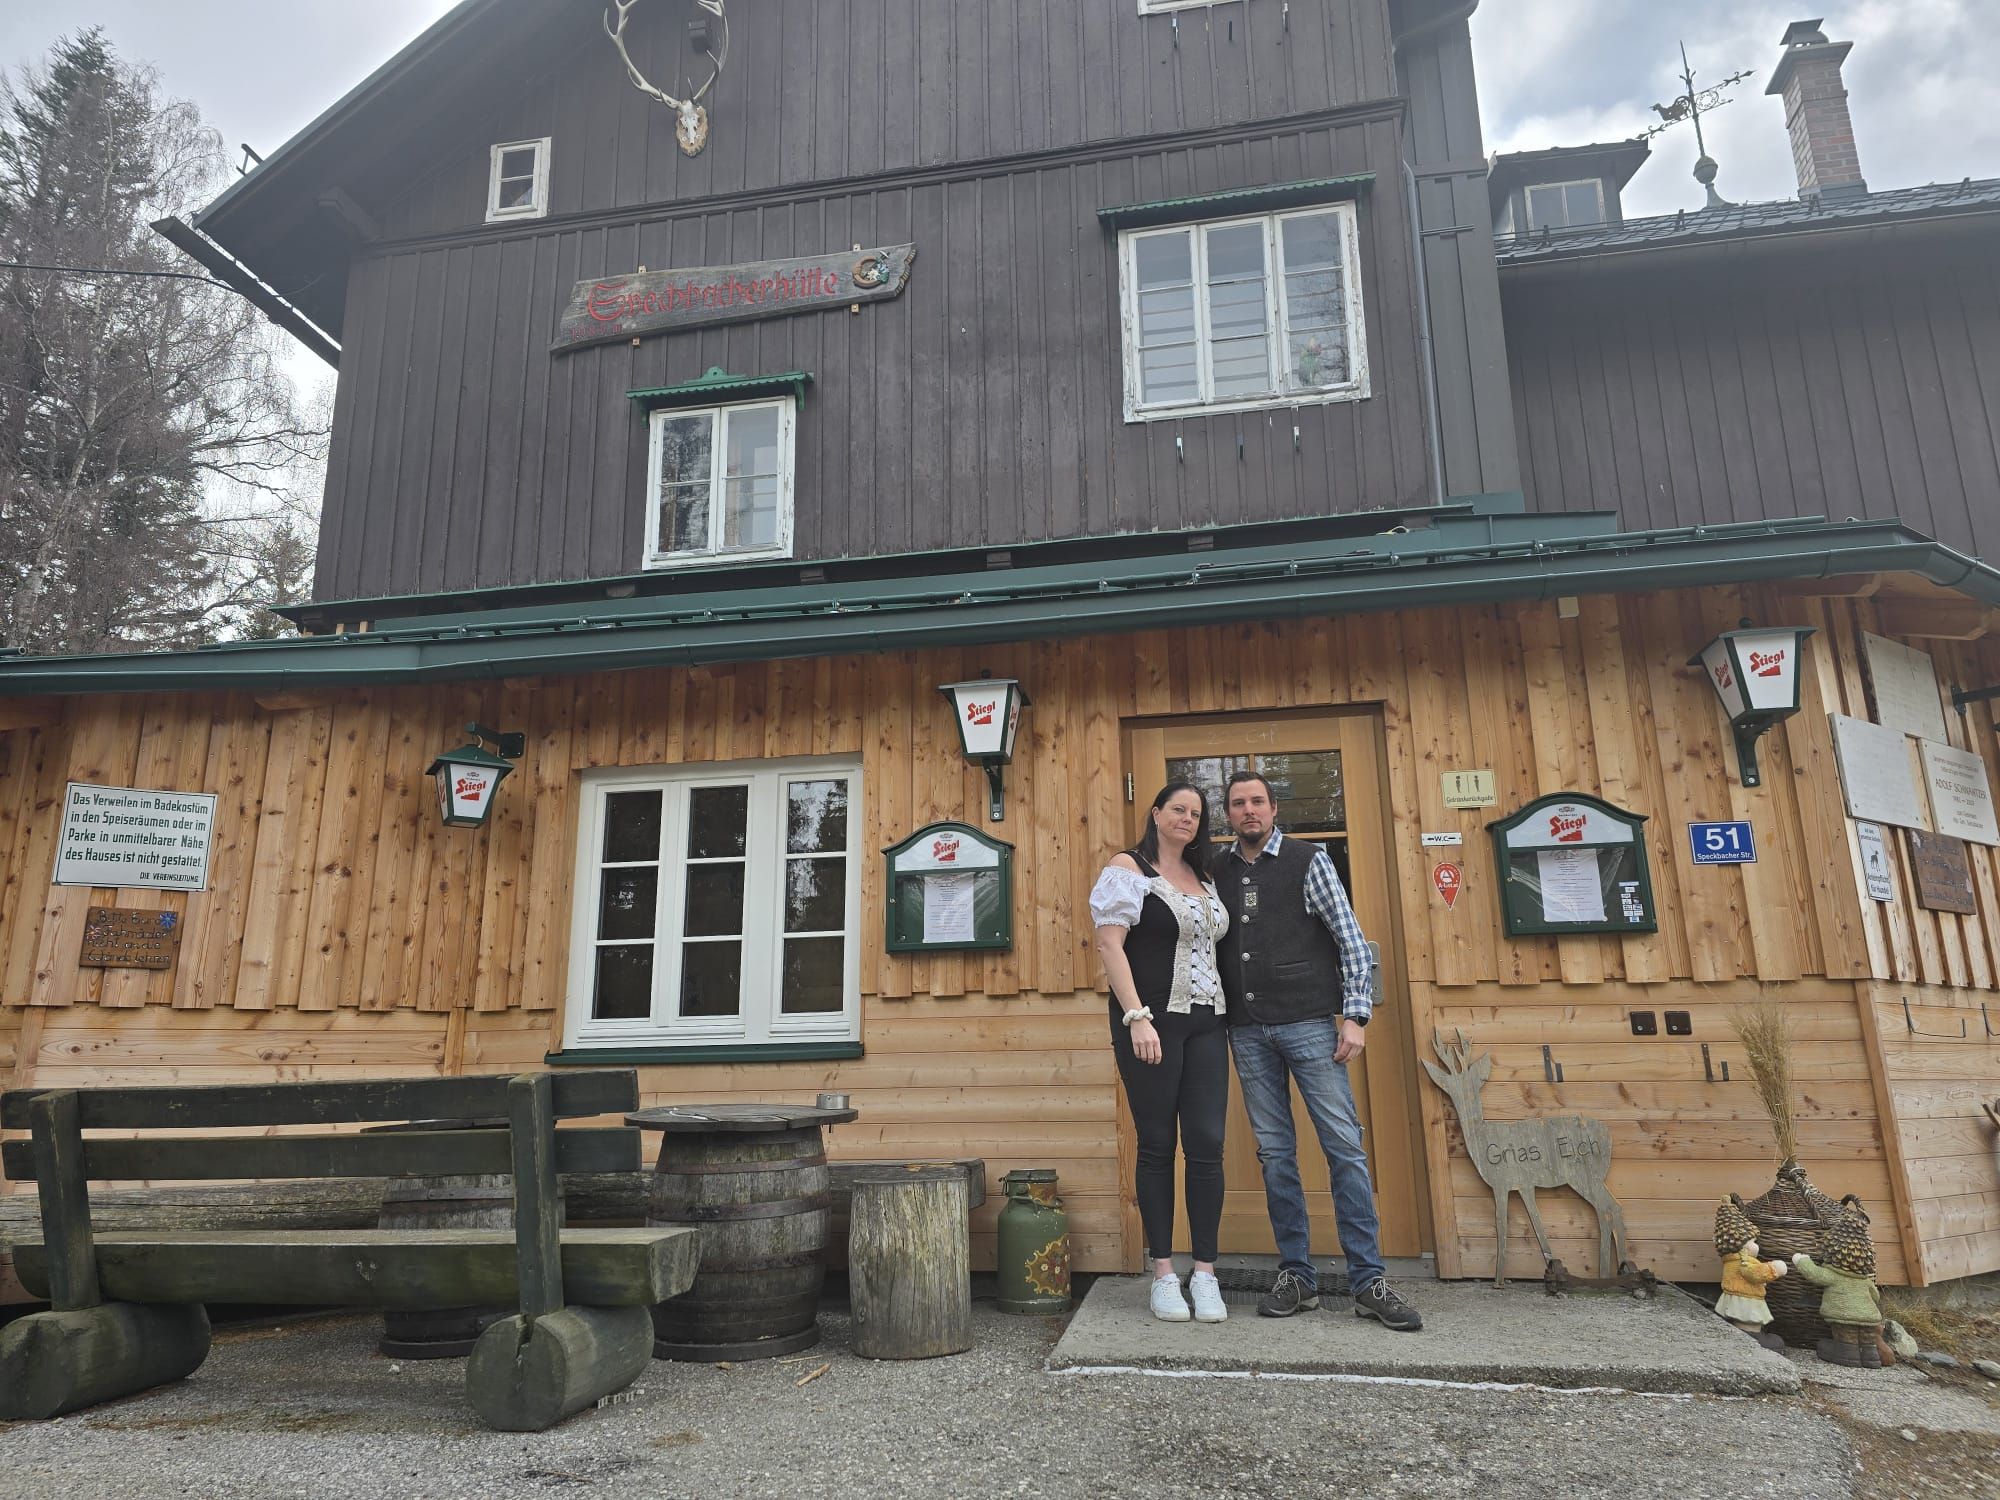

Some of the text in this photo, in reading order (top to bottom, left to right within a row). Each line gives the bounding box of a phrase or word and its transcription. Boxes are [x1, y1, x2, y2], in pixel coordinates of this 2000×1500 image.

[1749, 649, 1785, 673] Stiegl
[967, 700, 996, 721] Stiegl
[455, 778, 487, 795] Stiegl
[73, 792, 209, 815] Das Verweilen im Badekostüm
[70, 810, 207, 832] in den Speiseräumen oder im
[1549, 814, 1587, 837] Stiegl
[68, 827, 204, 849] Parke in unmittelbarer Nähe
[933, 839, 960, 858] Stiegl
[1705, 826, 1740, 851] 51
[65, 846, 84, 860] des
[85, 847, 121, 862] Hauses
[122, 850, 136, 863] ist
[137, 850, 160, 865] nicht
[1697, 852, 1740, 862] Speckbacher
[139, 871, 200, 883] DIE VEREINSLEITUNG
[1486, 1135, 1602, 1166] Grias Eich
